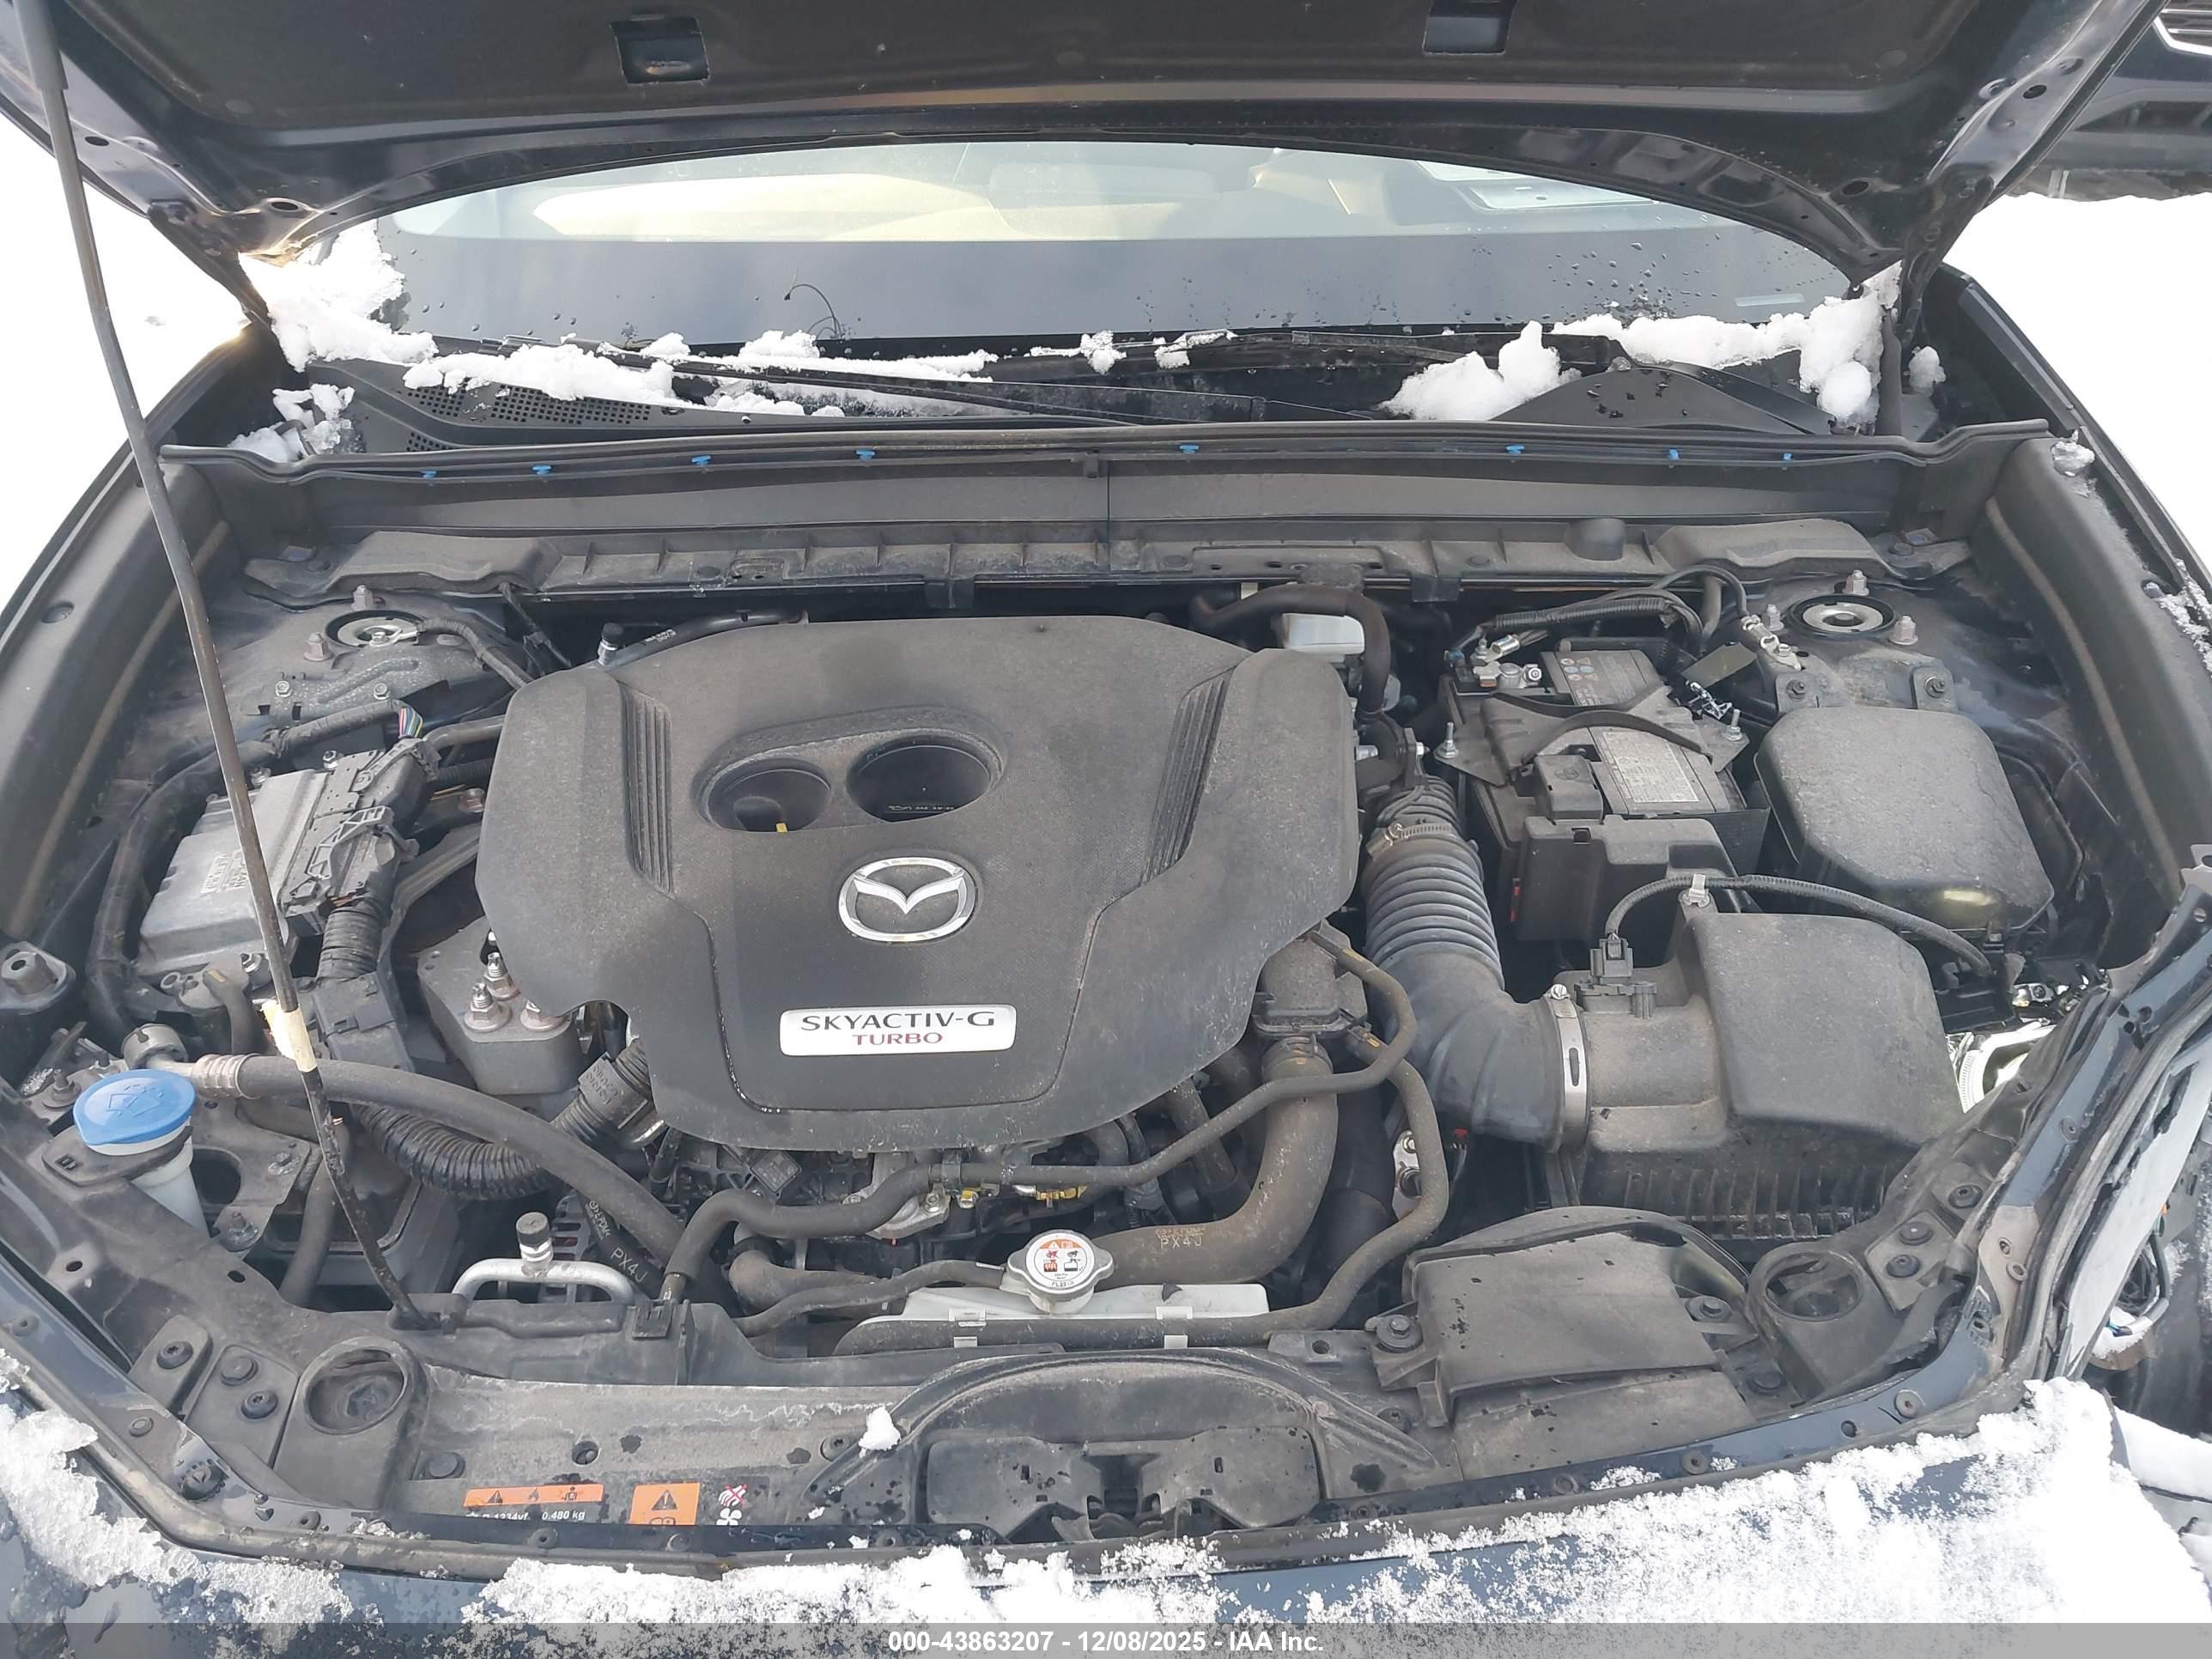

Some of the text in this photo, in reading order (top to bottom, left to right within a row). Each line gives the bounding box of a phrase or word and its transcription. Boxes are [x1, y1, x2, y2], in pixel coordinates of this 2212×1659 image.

[800, 1011, 996, 1031] SKYACTIV-G
[852, 1032, 944, 1046] TURBO
[1159, 1236, 1203, 1249] PX4J
[610, 1246, 648, 1283] PX4J
[542, 1510, 569, 1520] 0.480
[572, 1510, 586, 1521] kg
